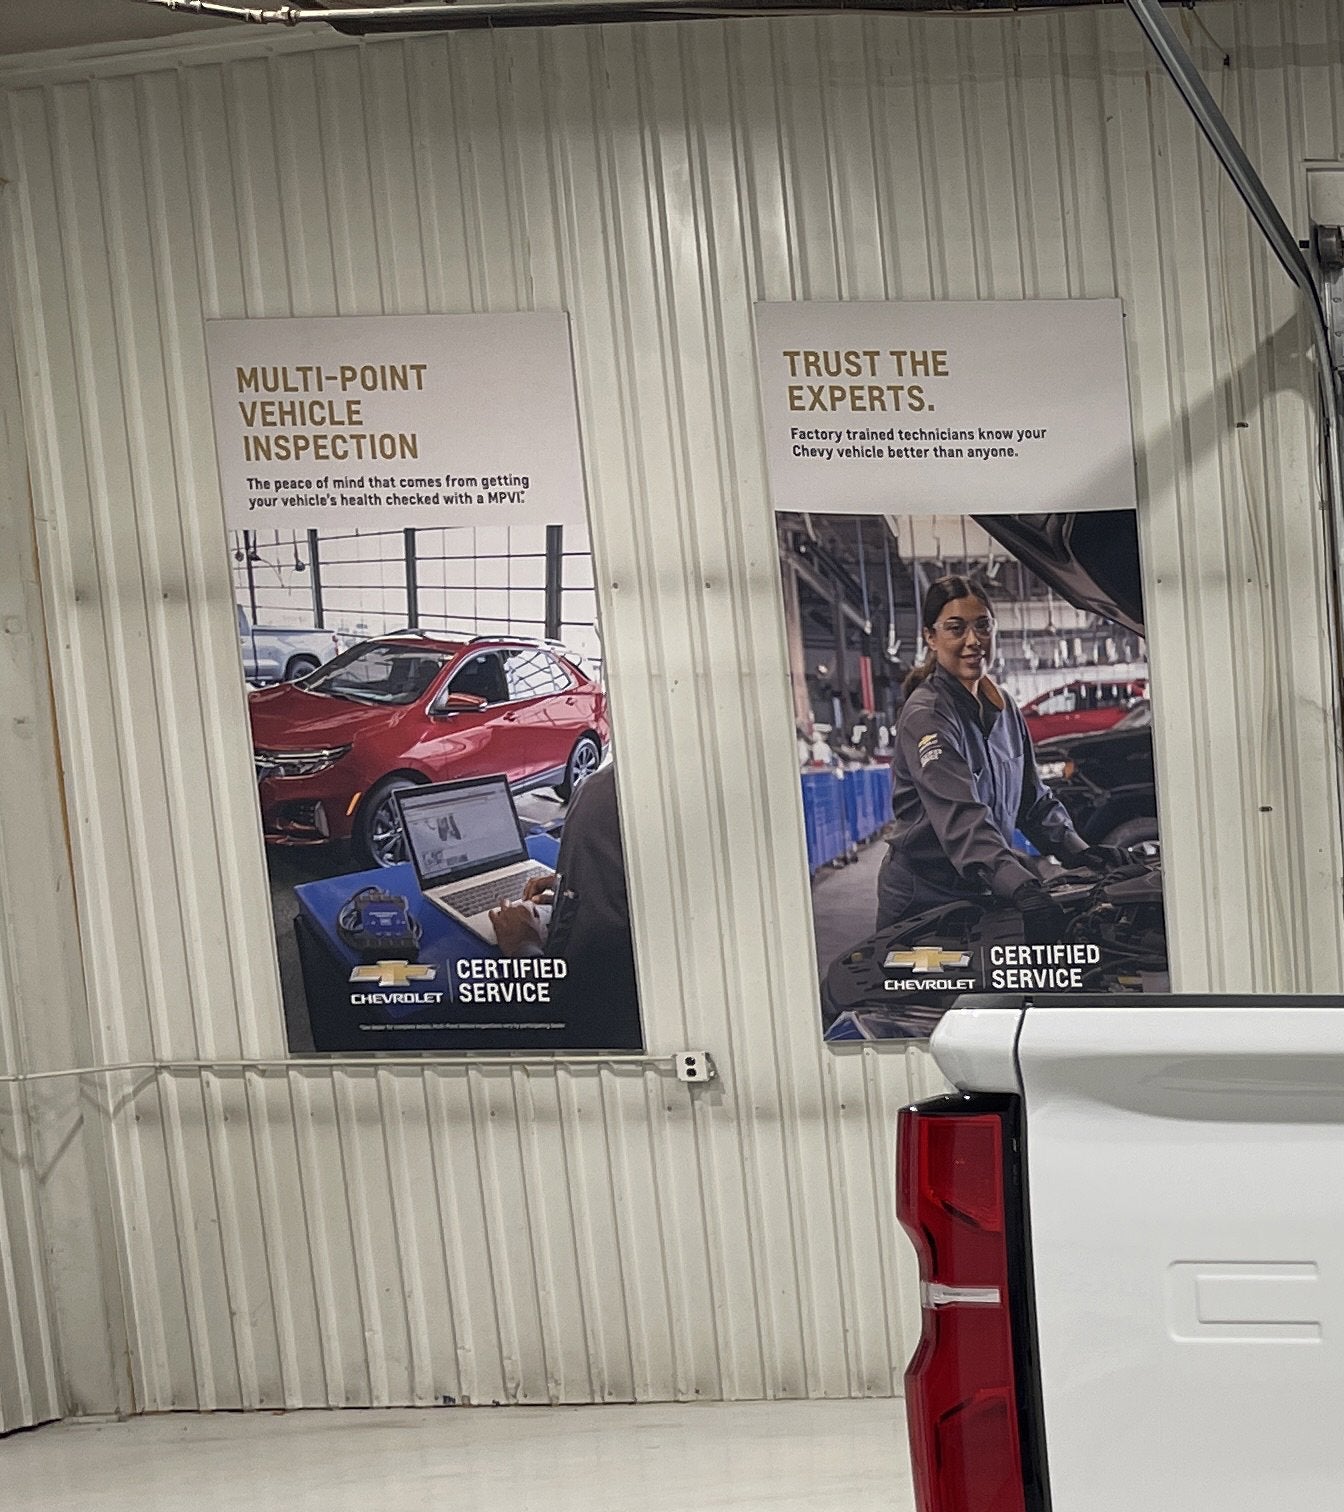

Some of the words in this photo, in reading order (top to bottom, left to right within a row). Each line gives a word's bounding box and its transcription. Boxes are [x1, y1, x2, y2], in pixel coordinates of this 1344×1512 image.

[783, 350, 880, 377] TRUST
[889, 350, 949, 377] THE
[236, 363, 428, 393] MULTI-POINT
[788, 385, 935, 412] EXPERTS.
[239, 399, 364, 428] VEHICLE
[791, 428, 842, 443] Factory
[846, 428, 894, 440] trained
[898, 428, 974, 440] technicians
[978, 428, 1013, 440] know
[1017, 429, 1047, 442] your
[243, 432, 419, 462] INSPECTION
[793, 445, 833, 460] Chevy
[837, 446, 884, 458] vehicle
[888, 446, 929, 458] better
[933, 446, 963, 458] than
[967, 447, 1018, 460] anyone.
[247, 477, 270, 489] The
[274, 479, 312, 492] peace
[316, 476, 328, 489] of
[333, 476, 364, 489] mind
[369, 476, 395, 488] that
[400, 477, 442, 488] comes
[446, 474, 477, 487] from
[481, 473, 529, 490] getting
[249, 496, 277, 510] your
[281, 494, 337, 506] vehicle's
[341, 493, 381, 506] health
[386, 493, 440, 505] checked
[443, 492, 473, 504] with
[477, 495, 484, 504] a
[989, 944, 1100, 966] CERTIFIED
[456, 958, 567, 979] CERTIFIED
[991, 968, 1083, 989] SERVICE
[459, 982, 550, 1003] SERVICE
[884, 979, 976, 990] CHEVROLET
[351, 992, 443, 1005] CHEVROLET
